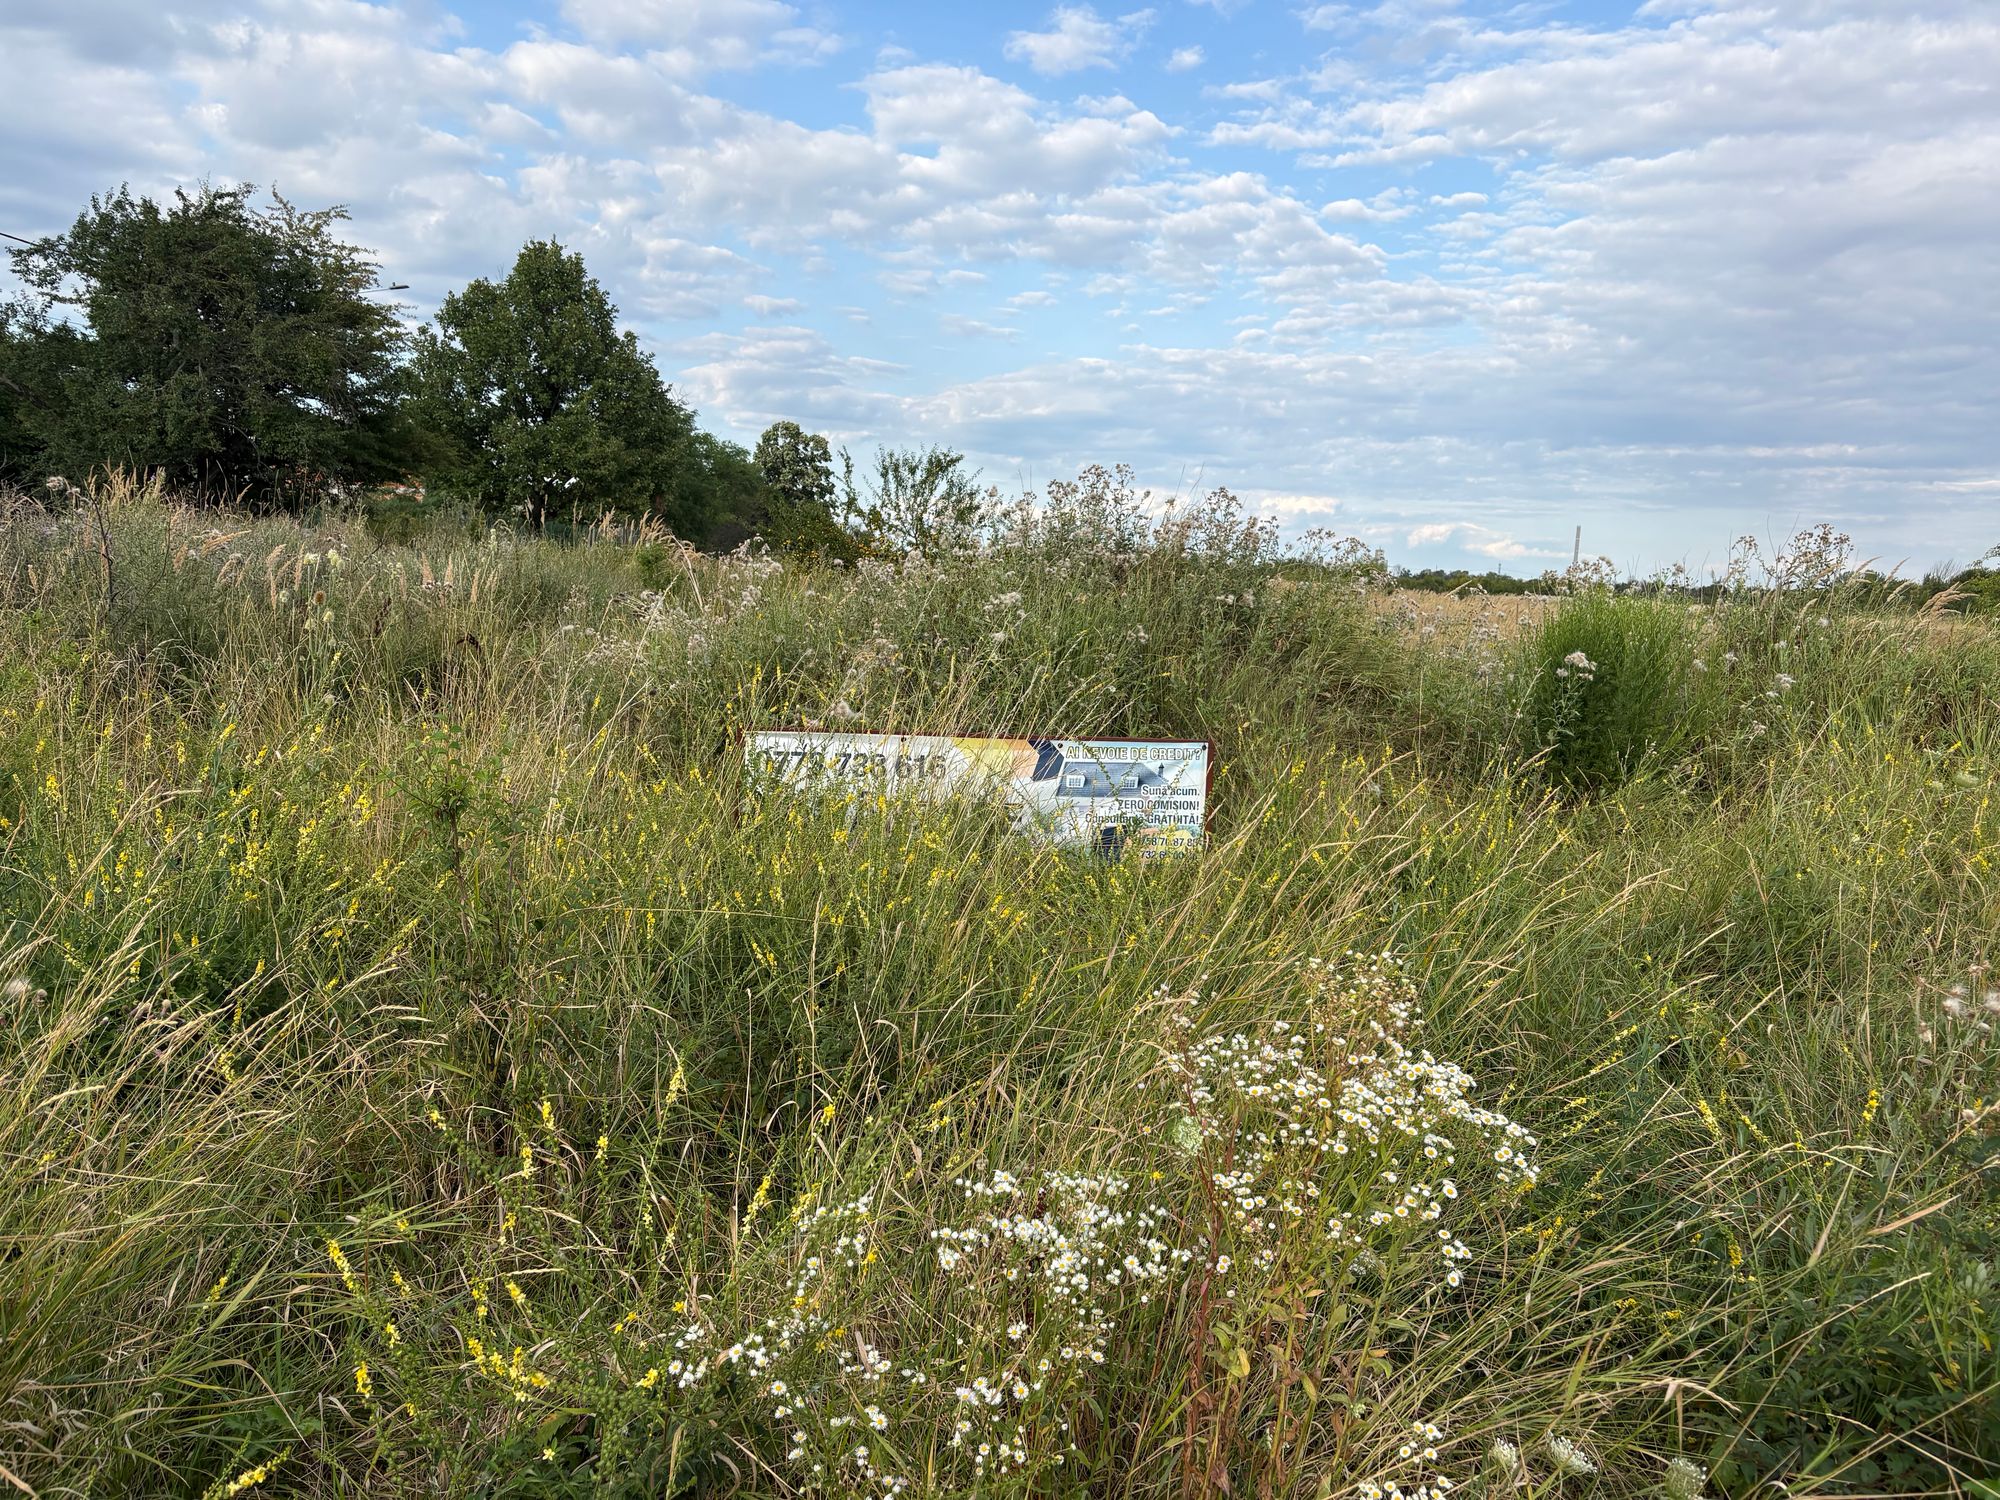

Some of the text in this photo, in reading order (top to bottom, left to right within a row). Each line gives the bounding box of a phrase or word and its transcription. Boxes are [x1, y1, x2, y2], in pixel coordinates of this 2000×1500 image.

[1066, 746, 1080, 759] AI
[1130, 747, 1148, 760] DE
[1150, 748, 1203, 760] CREDIT?
[1119, 799, 1200, 810] ZERO COMISION!
